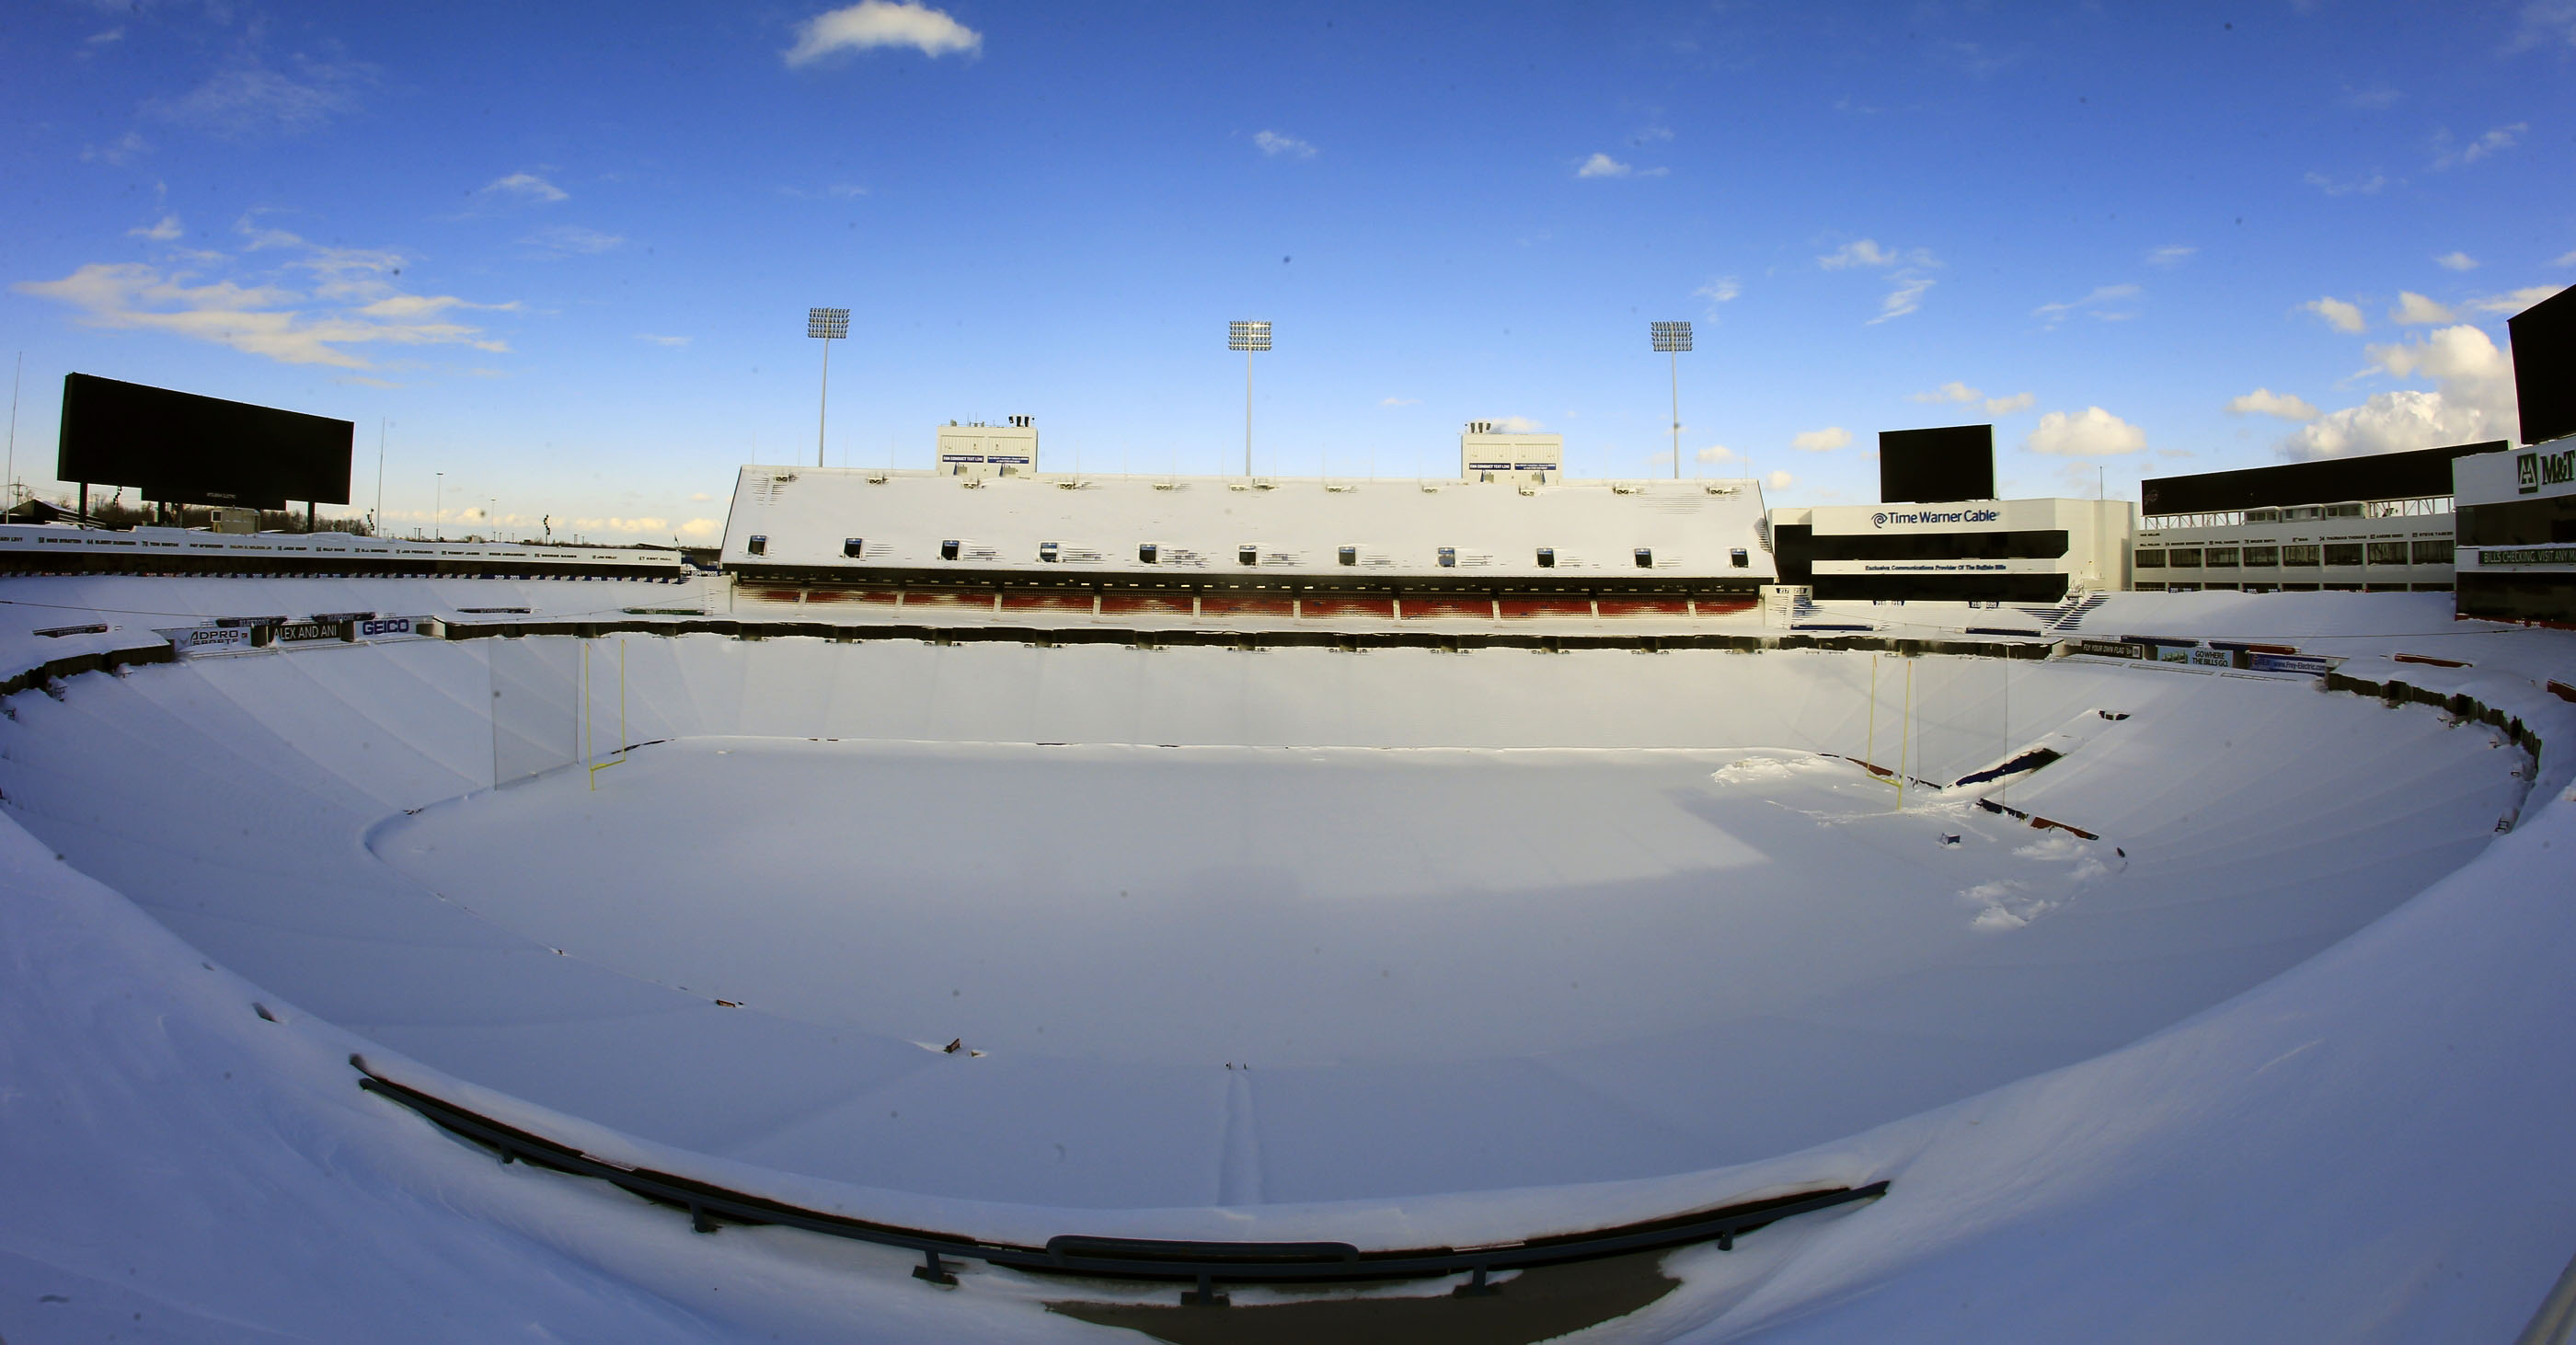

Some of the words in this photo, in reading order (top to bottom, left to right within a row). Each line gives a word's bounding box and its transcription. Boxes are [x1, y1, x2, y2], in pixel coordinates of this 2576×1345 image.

[2540, 450, 2576, 486] M&T
[1888, 512, 1917, 523] Time
[1919, 512, 1962, 523] Warner
[1964, 510, 1996, 521] Cable
[2484, 552, 2501, 563] BILLS
[298, 626, 318, 638] AND
[321, 625, 337, 638] ANI
[362, 619, 409, 635] GEICO
[190, 630, 238, 642] ADPRO
[2203, 658, 2217, 666] BILLS
